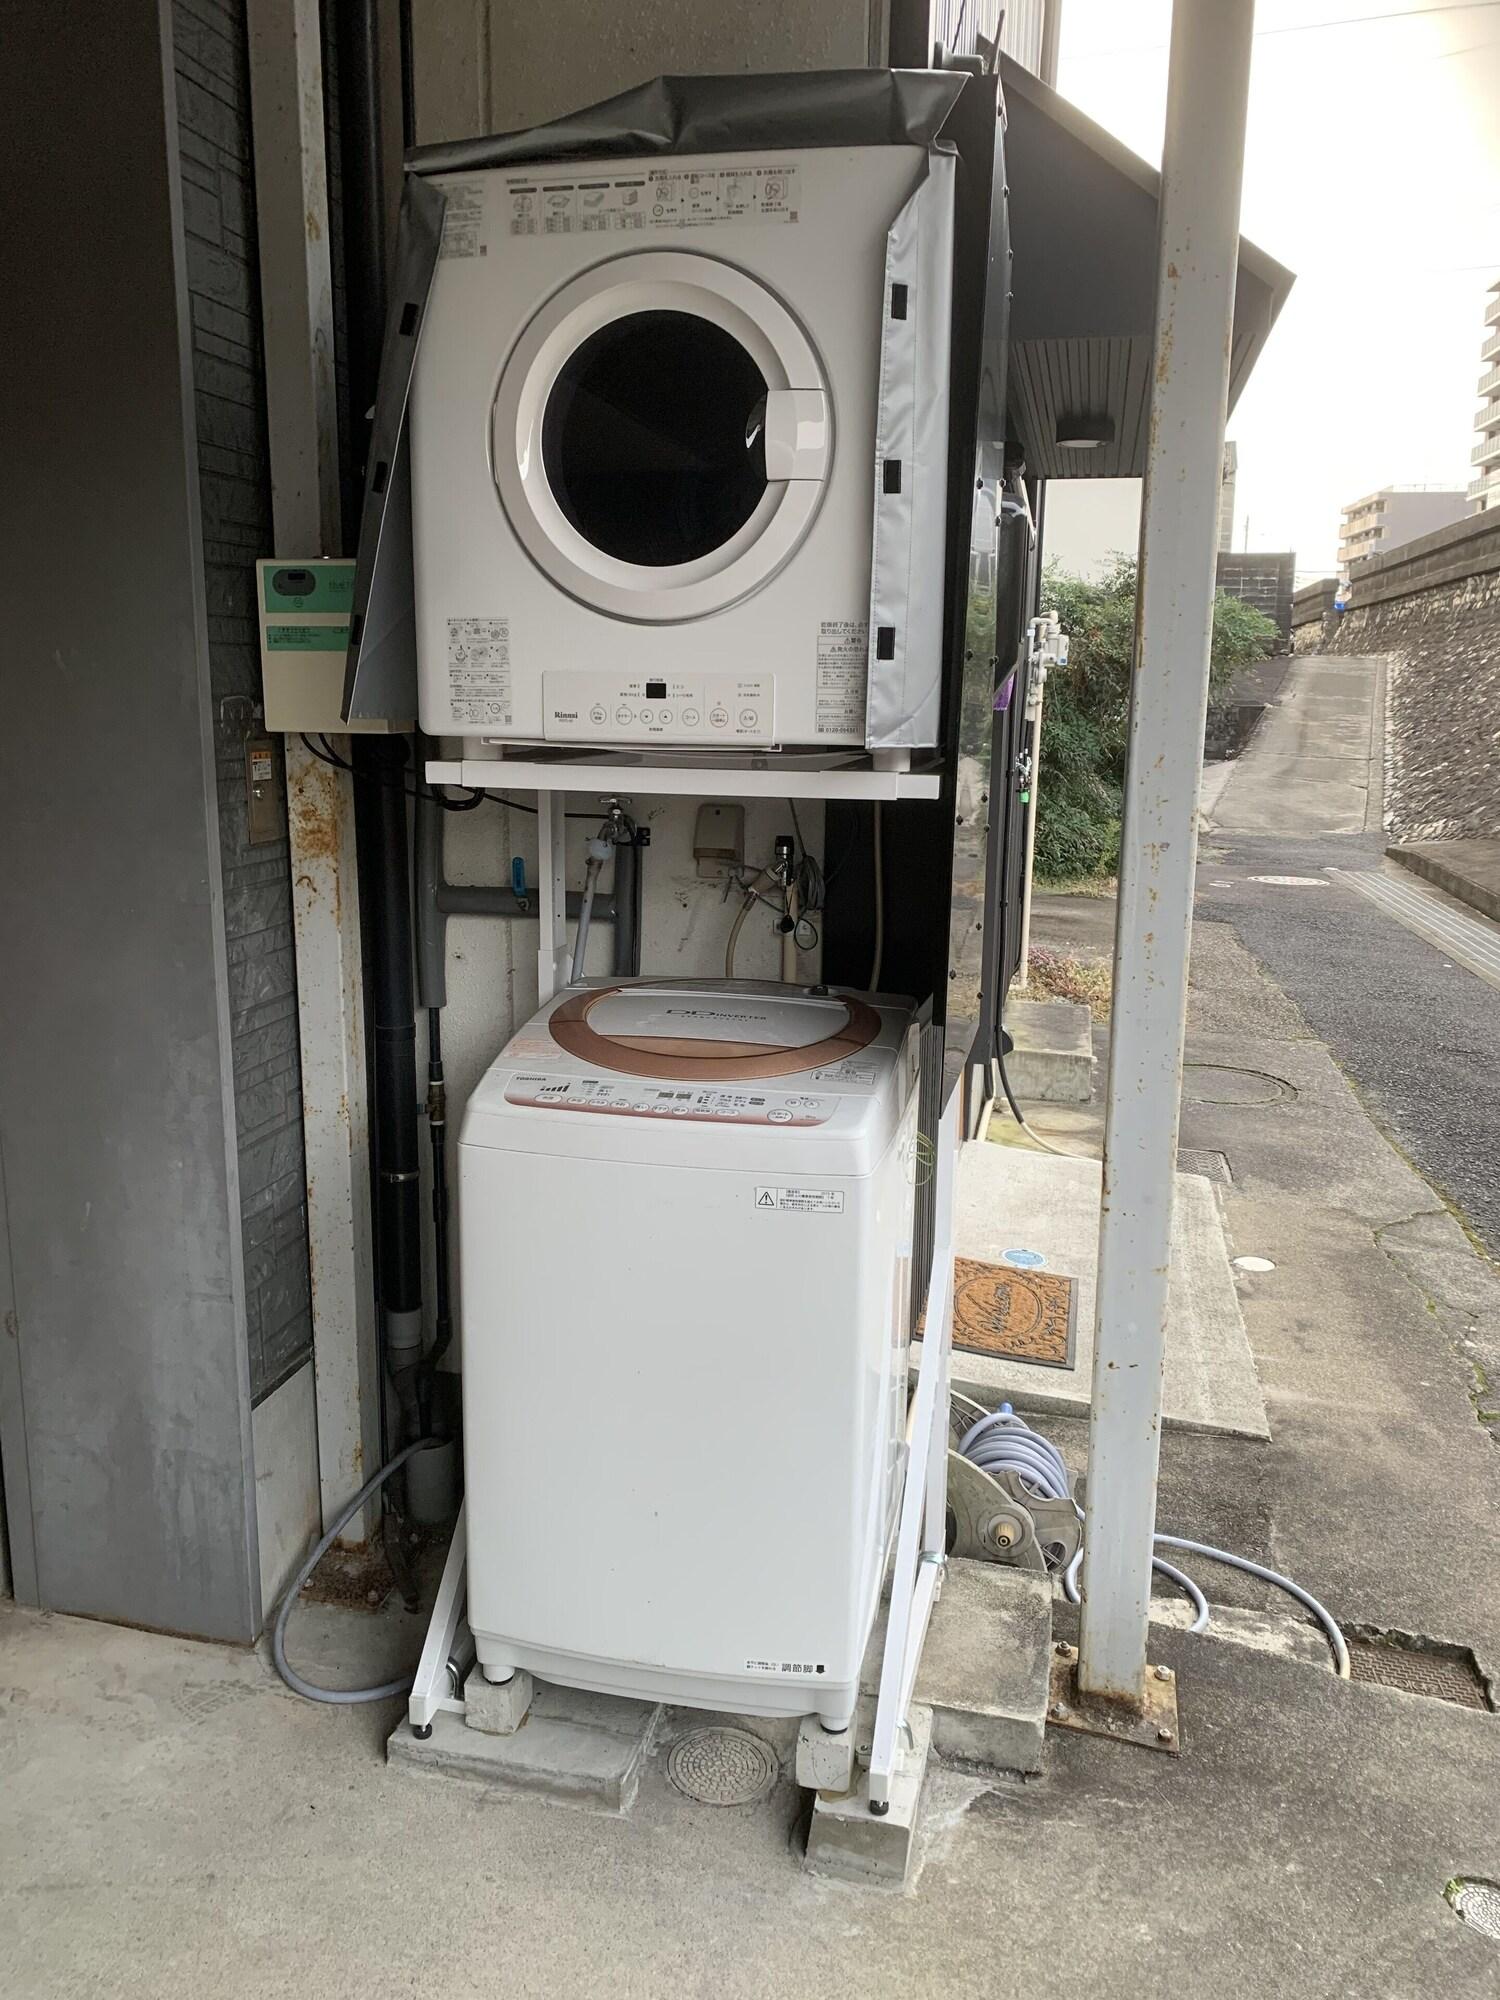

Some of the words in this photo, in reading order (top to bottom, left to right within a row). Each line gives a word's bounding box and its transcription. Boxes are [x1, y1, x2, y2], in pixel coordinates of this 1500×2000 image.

[554, 711, 578, 719] Rinnai
[781, 1663, 814, 1673] 調節脚
